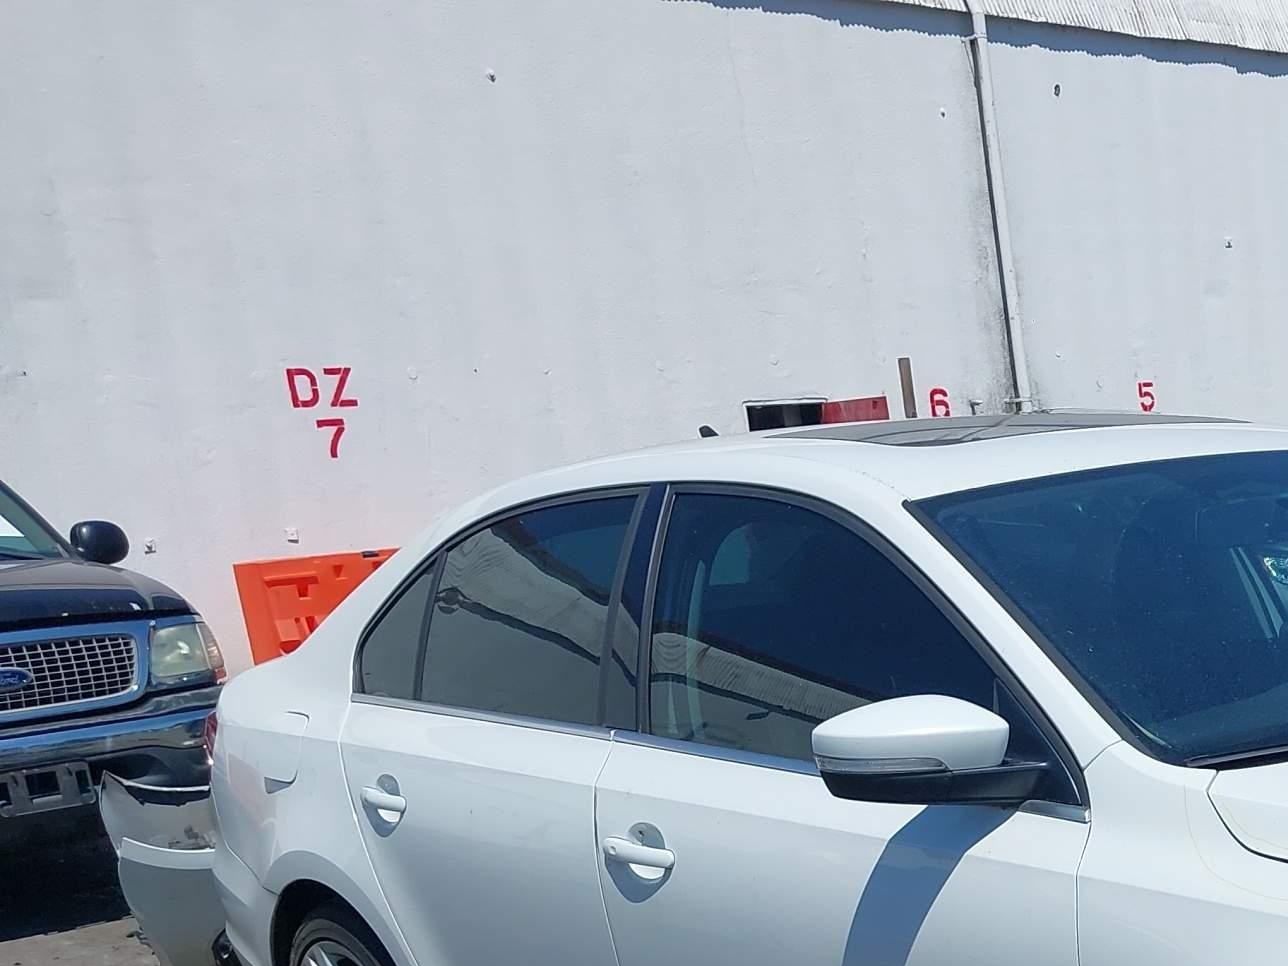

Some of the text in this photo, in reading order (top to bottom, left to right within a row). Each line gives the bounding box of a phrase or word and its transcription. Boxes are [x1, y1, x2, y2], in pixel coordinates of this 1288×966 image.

[285, 367, 359, 409] DZ
[929, 388, 951, 417] 6
[1137, 381, 1156, 413] 5
[315, 418, 346, 459] 7
